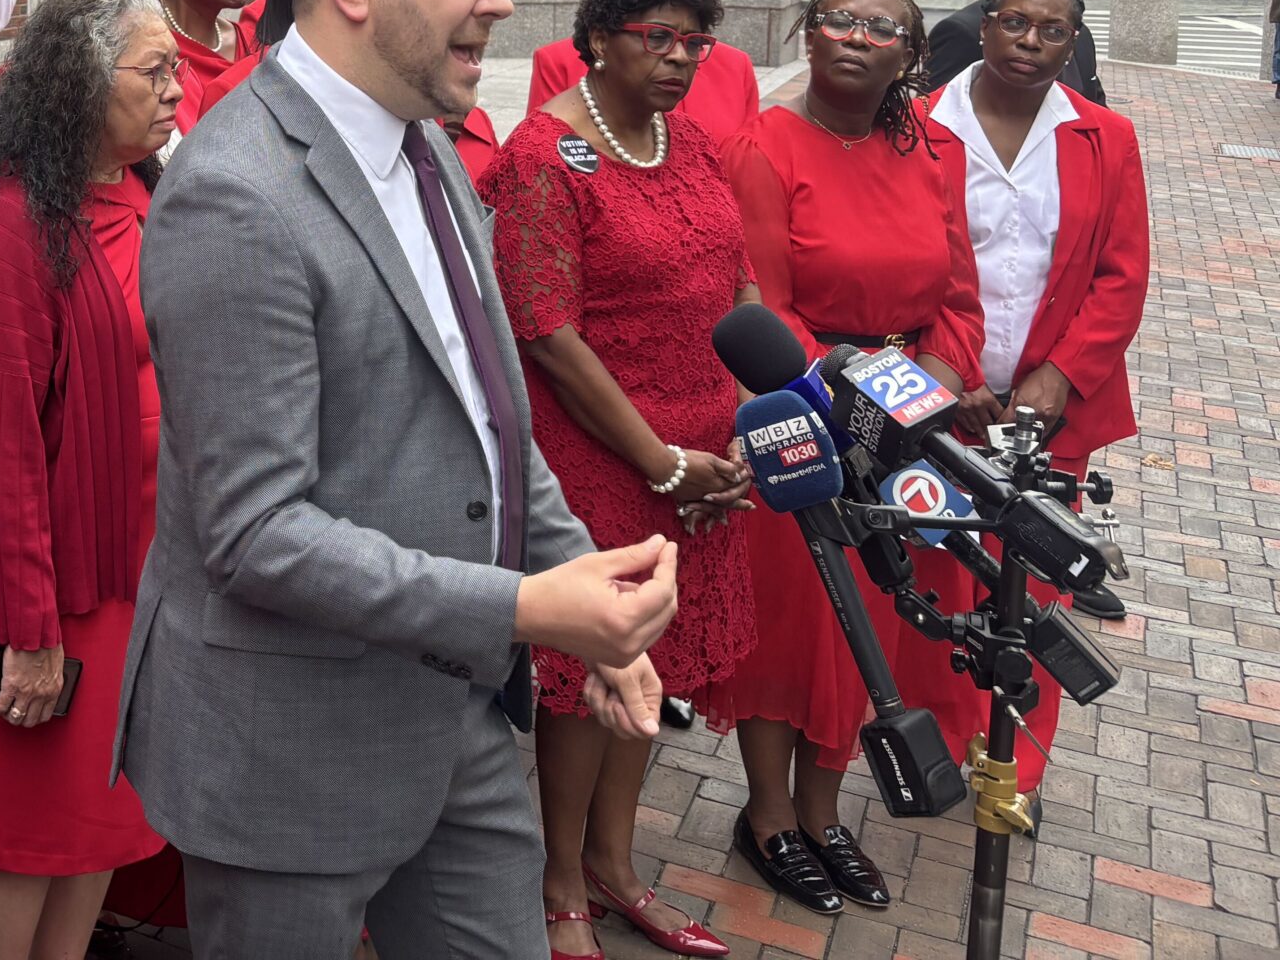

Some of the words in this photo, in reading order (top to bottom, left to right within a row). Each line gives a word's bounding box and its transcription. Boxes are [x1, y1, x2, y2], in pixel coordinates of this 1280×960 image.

[560, 140, 588, 148] VOTING
[852, 352, 903, 383] BOSTON
[871, 362, 927, 409] 25
[847, 393, 869, 436] YOUR
[902, 392, 944, 420] NEWS
[754, 432, 815, 457] NEWSRADIO
[858, 406, 878, 447] LOCAL
[868, 409, 887, 453] STATION
[781, 443, 818, 464] 1030
[902, 477, 936, 510] 7
[817, 557, 842, 609] SENNHEISER
[881, 738, 906, 786] SENNHEISER
